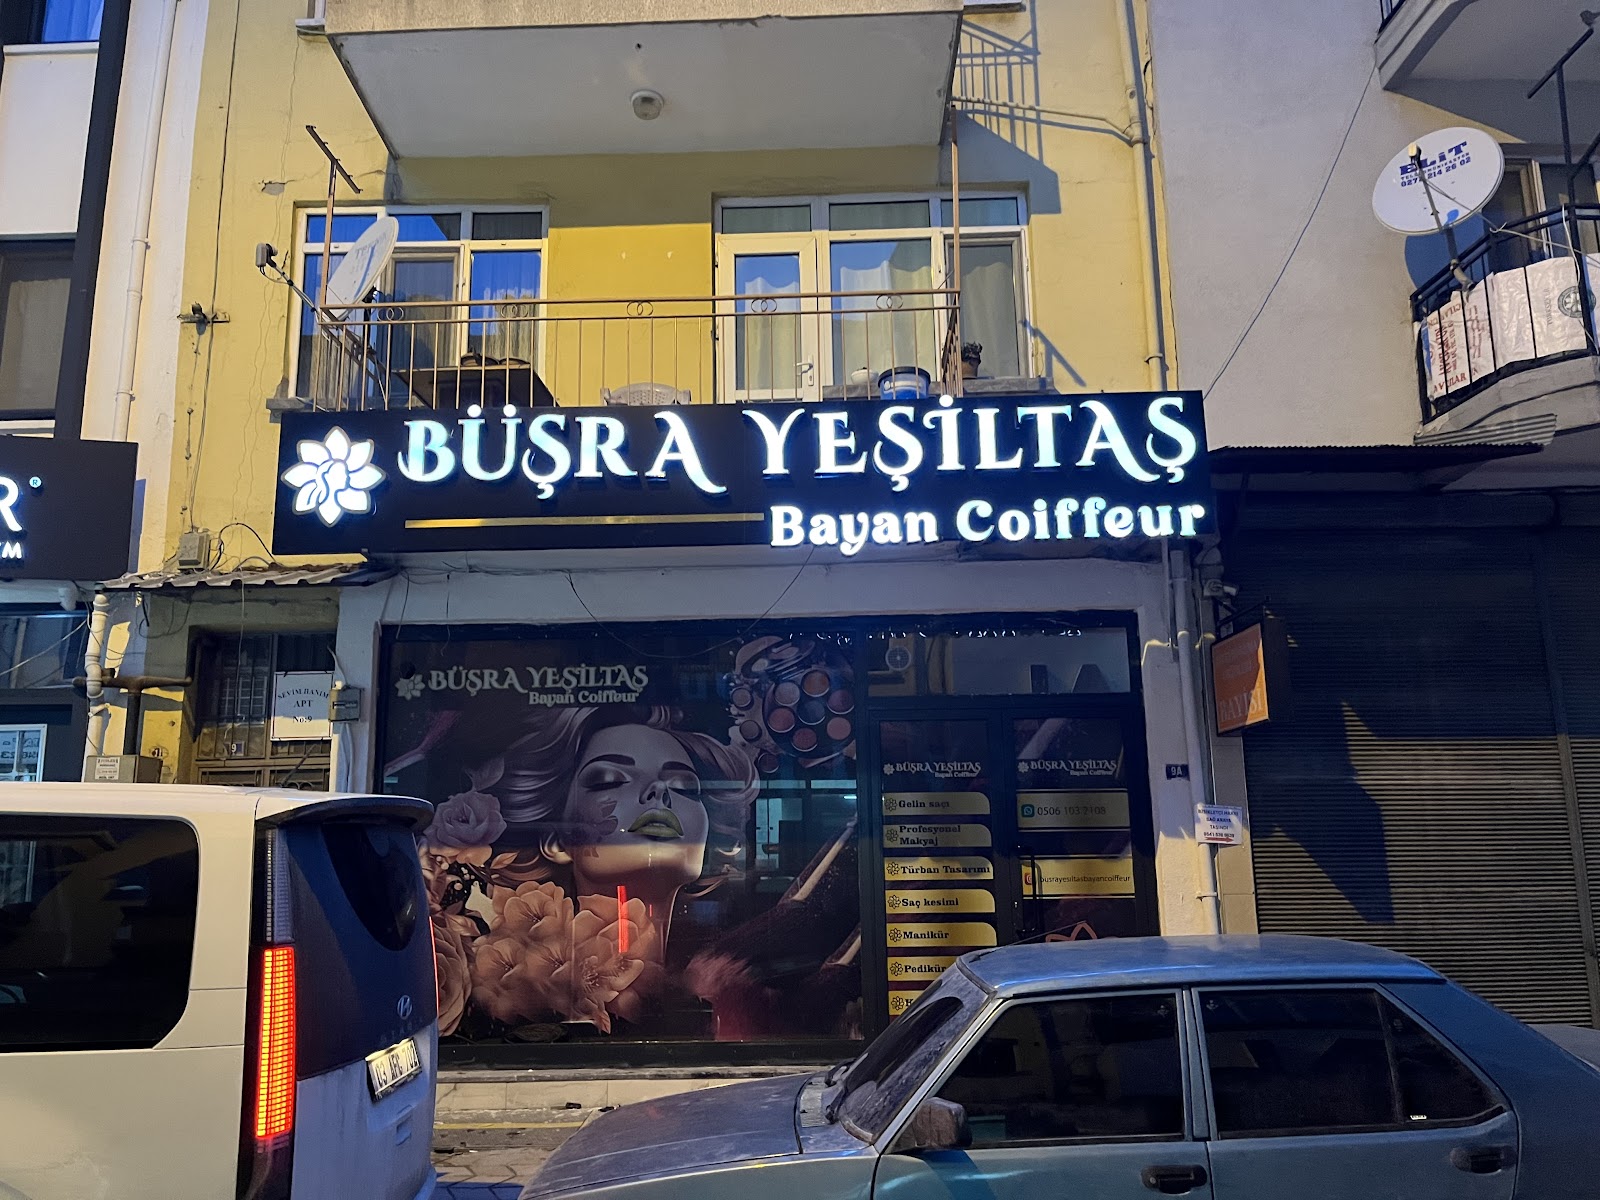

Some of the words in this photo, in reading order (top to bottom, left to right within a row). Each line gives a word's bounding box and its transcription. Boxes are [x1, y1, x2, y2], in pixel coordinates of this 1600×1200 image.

[1401, 176, 1422, 187] 027
[1427, 169, 1443, 179] 214
[1445, 163, 1457, 173] 26
[1460, 156, 1471, 166] 02
[397, 403, 728, 500] BÜŞRA
[742, 395, 1197, 493] YEŞİLTAŞ
[770, 504, 938, 556] Bayan
[956, 497, 1205, 542] Coiffeur
[428, 665, 528, 696] BÜŞRA
[526, 663, 649, 694] YEŞİLTAŞ
[529, 691, 575, 707] Bayan
[578, 688, 640, 703] Coiffeur
[294, 700, 313, 708] APT
[293, 715, 313, 723] No:9
[231, 744, 237, 753] 9
[895, 761, 935, 774] BÜŞRA
[933, 760, 981, 776] YEŞİLTAŞ
[1030, 760, 1069, 772] BÜŞRA
[1068, 759, 1117, 773] YEŞİLTAŞ
[1171, 766, 1183, 776] 9A
[898, 800, 926, 808] Gelin
[1037, 806, 1061, 816] 0506
[899, 825, 961, 835] Profesyonel
[899, 837, 938, 847] Makyaj
[901, 865, 939, 874] Türban
[942, 865, 990, 874] Tasarımı
[901, 898, 920, 908] Saç
[923, 897, 959, 906] kesimi
[903, 930, 949, 939] Manikür
[904, 964, 946, 973] Pedikür
